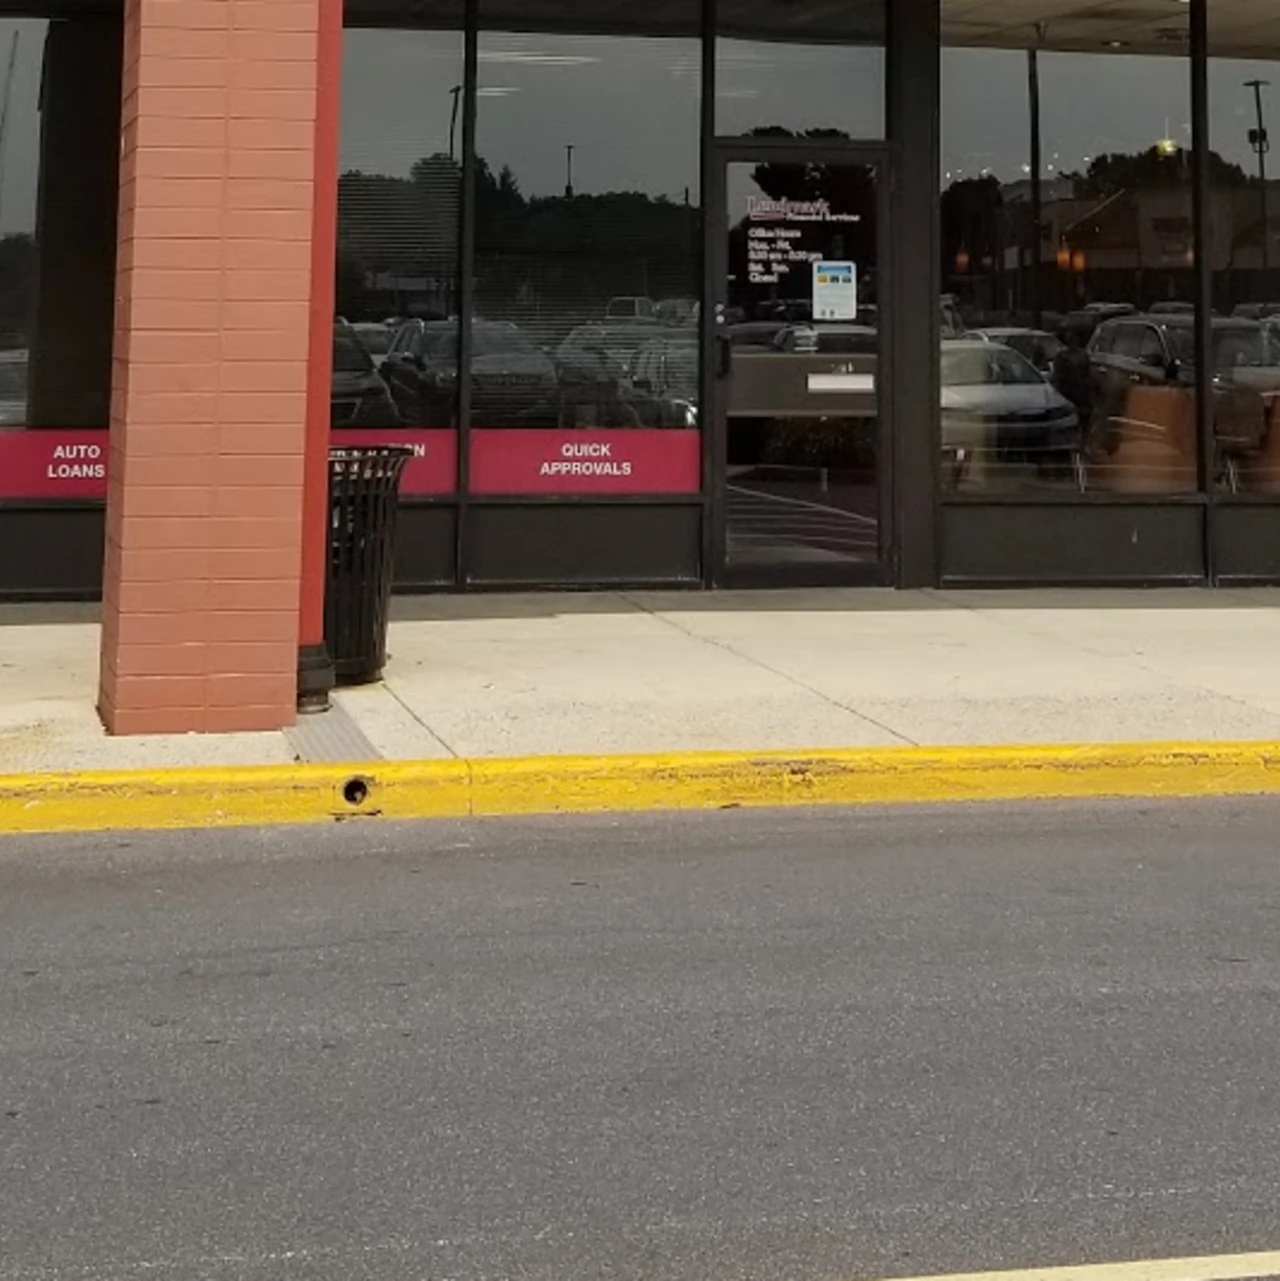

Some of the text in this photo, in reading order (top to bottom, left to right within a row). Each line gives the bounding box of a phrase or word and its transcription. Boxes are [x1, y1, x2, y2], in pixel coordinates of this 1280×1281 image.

[54, 445, 101, 459] AUTO
[562, 443, 611, 457] QUICK
[47, 464, 105, 478] LOANS
[540, 462, 632, 476] APPROVALS
